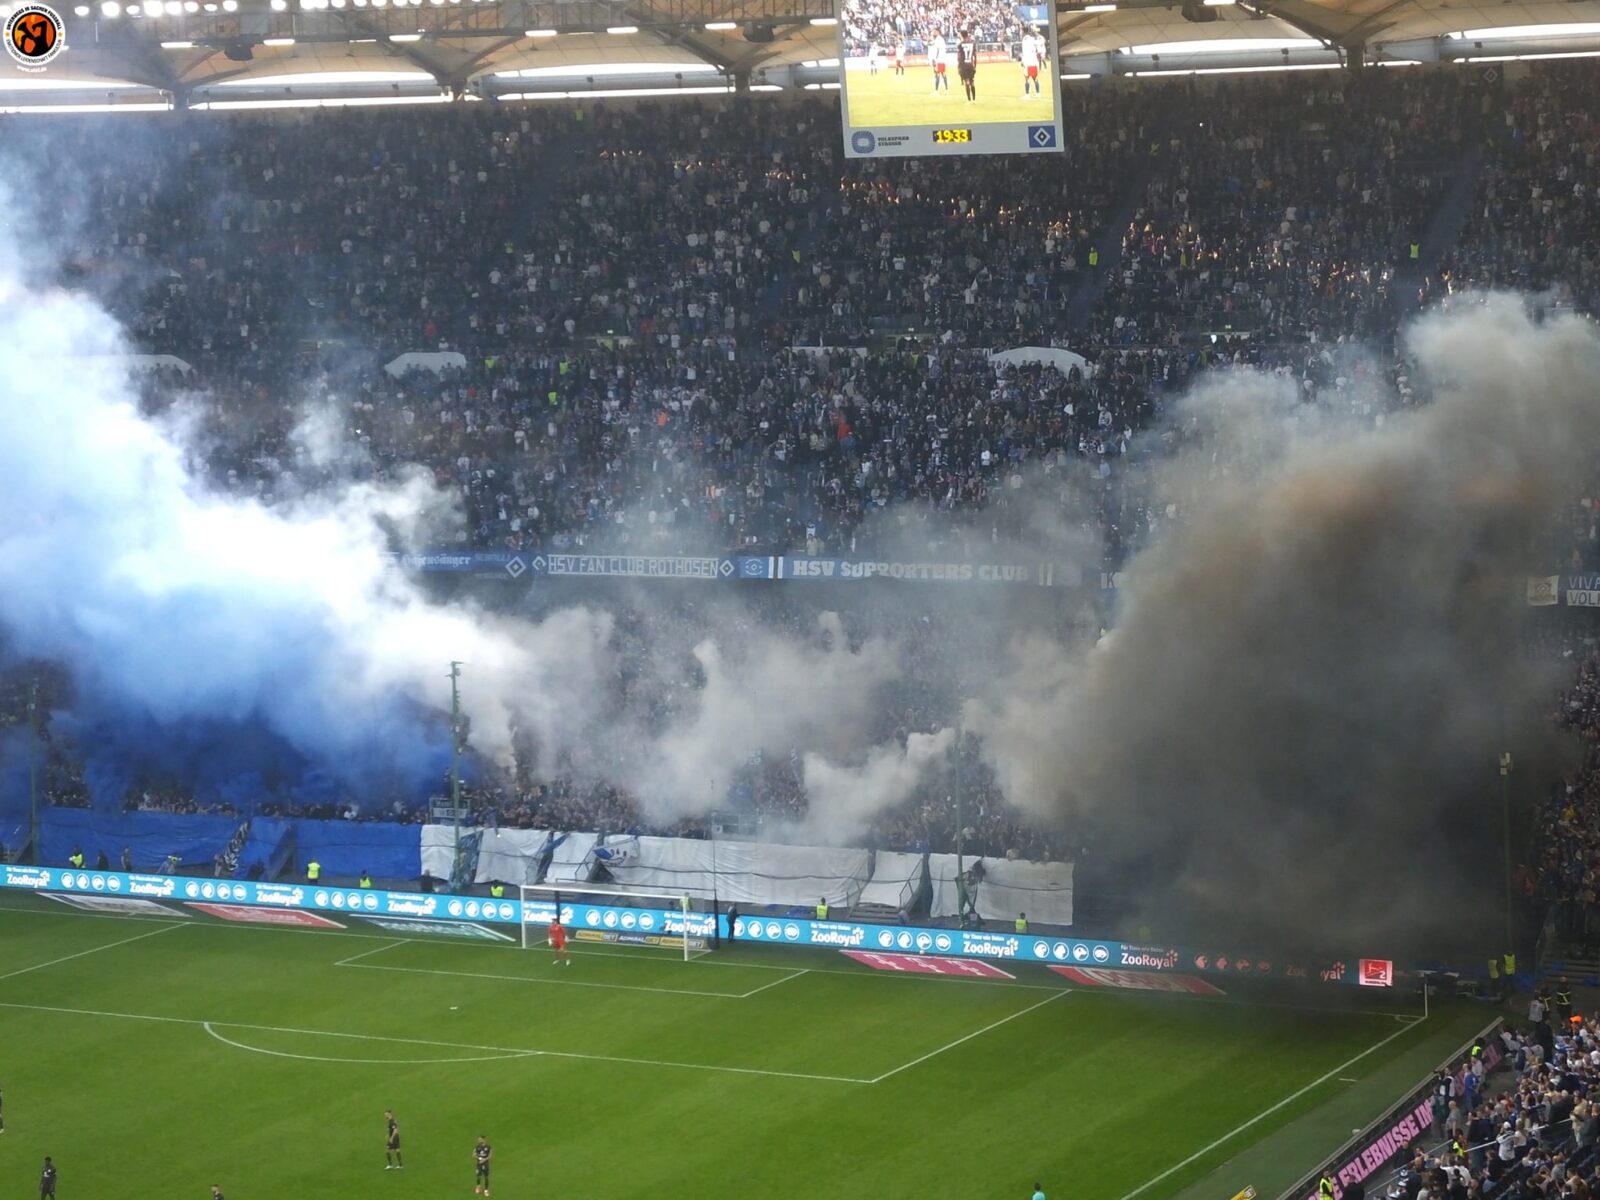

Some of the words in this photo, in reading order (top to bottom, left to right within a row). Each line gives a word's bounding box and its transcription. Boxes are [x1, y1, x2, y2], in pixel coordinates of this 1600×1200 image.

[936, 129, 968, 143] 19:33
[550, 557, 575, 572] HSV
[580, 558, 605, 573] FAN
[609, 558, 643, 574] CLUB
[650, 559, 718, 576] ROTHOSEN
[793, 560, 835, 576] HSV
[840, 561, 973, 580] SUPPORTERS
[978, 564, 1028, 581] CLUB
[811, 930, 861, 947] ZooRoyal
[963, 941, 1014, 958] ZooRoyal
[1121, 953, 1174, 970] ZooRoyal
[1379, 970, 1386, 979] 2
[1338, 1114, 1420, 1187] ERLEBNISSE
